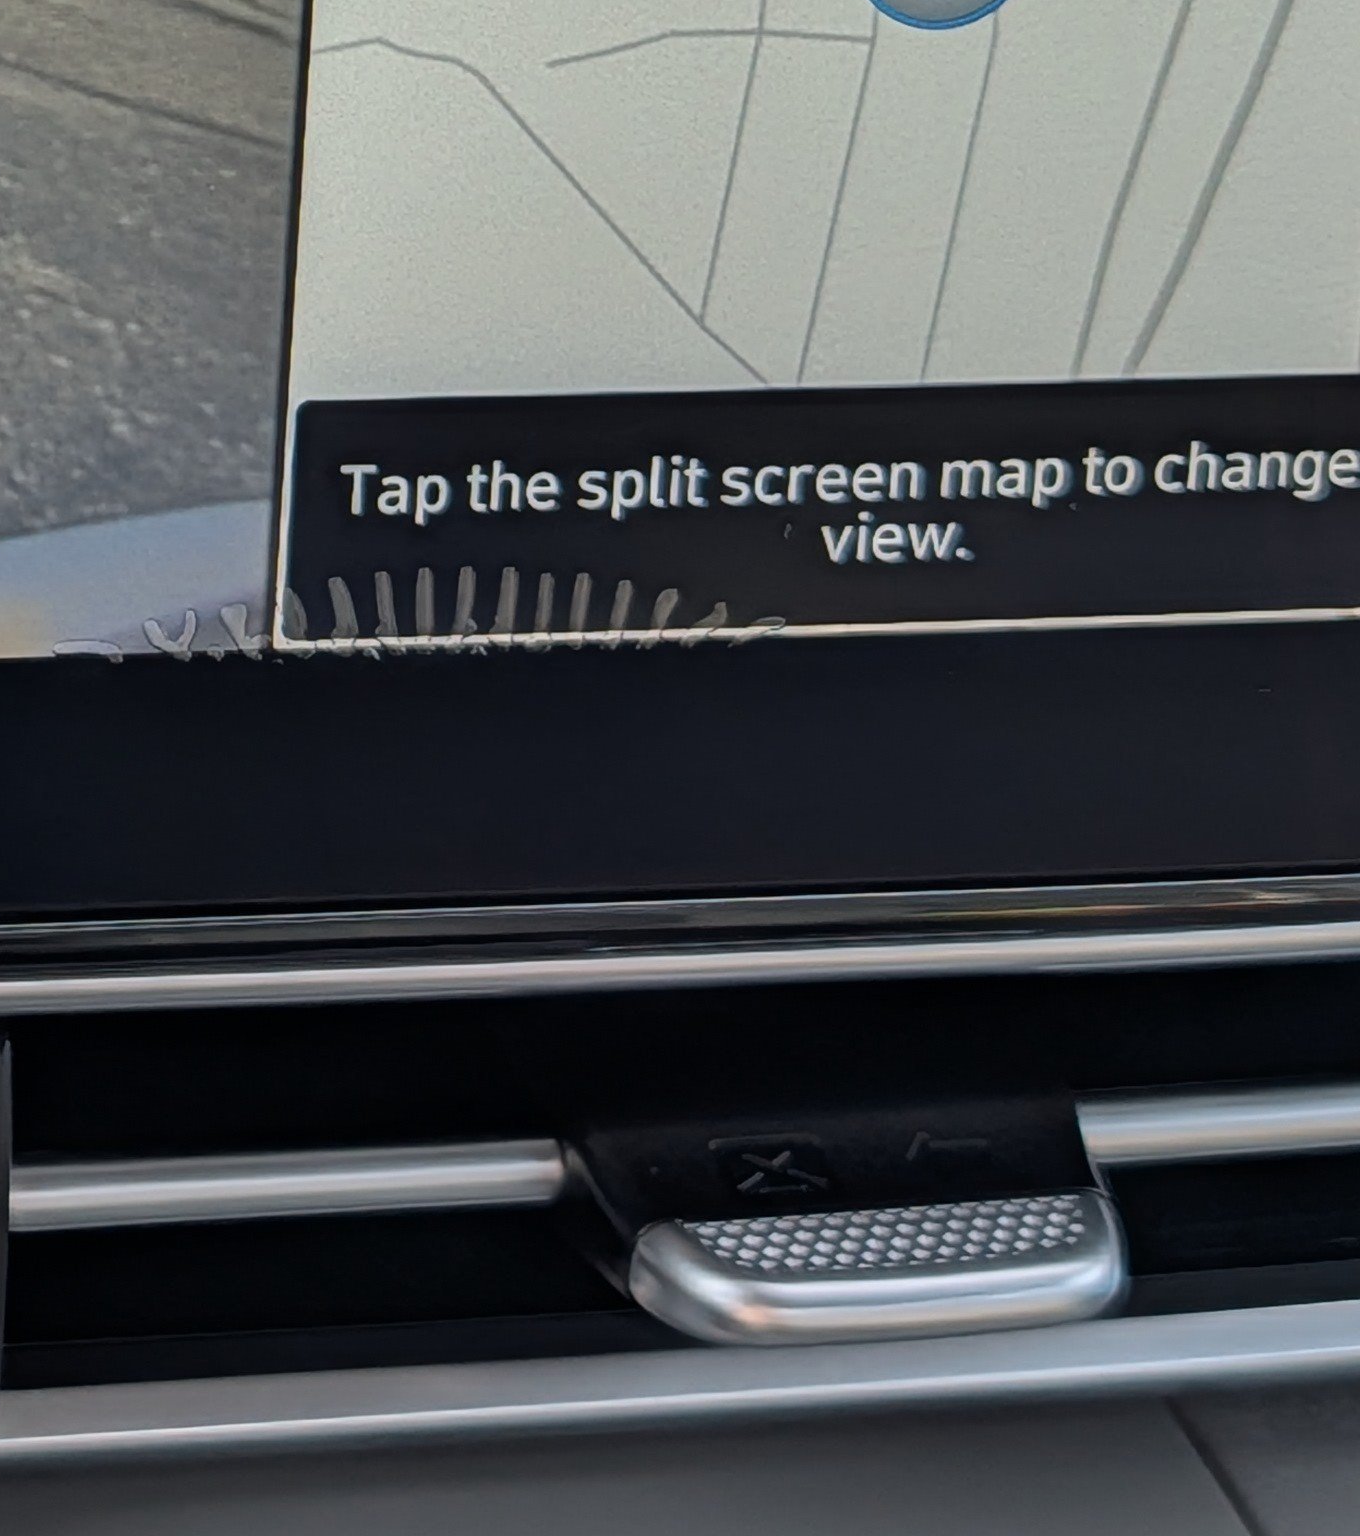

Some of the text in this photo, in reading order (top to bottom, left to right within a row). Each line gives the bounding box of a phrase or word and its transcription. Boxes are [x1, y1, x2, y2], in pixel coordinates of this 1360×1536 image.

[340, 439, 1360, 525] Tap the split screen map to change
[821, 511, 975, 566] view.
